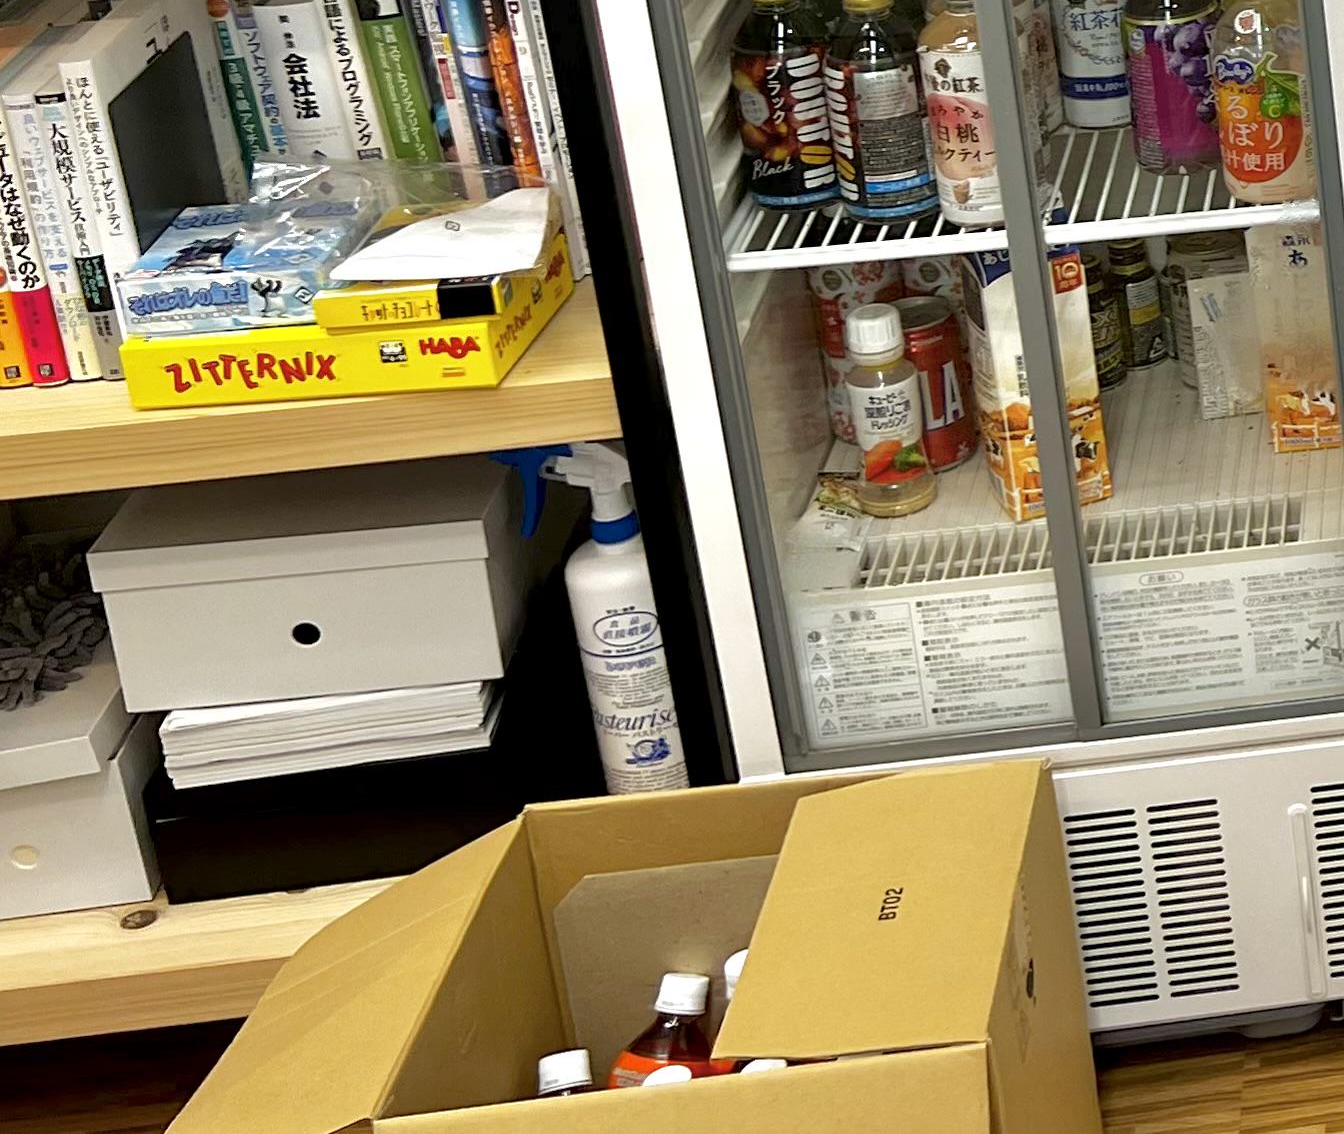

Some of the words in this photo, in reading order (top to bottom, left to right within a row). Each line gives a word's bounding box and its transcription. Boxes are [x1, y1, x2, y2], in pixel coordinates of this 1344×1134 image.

[282, 52, 320, 119] 会社法
[766, 63, 786, 125] ブラック
[1268, 104, 1281, 119] C
[936, 123, 980, 144] 白桃
[752, 160, 795, 181] Black
[420, 336, 482, 360] HABA
[165, 352, 338, 395] ZITTERNIX
[878, 887, 904, 921] BT02
